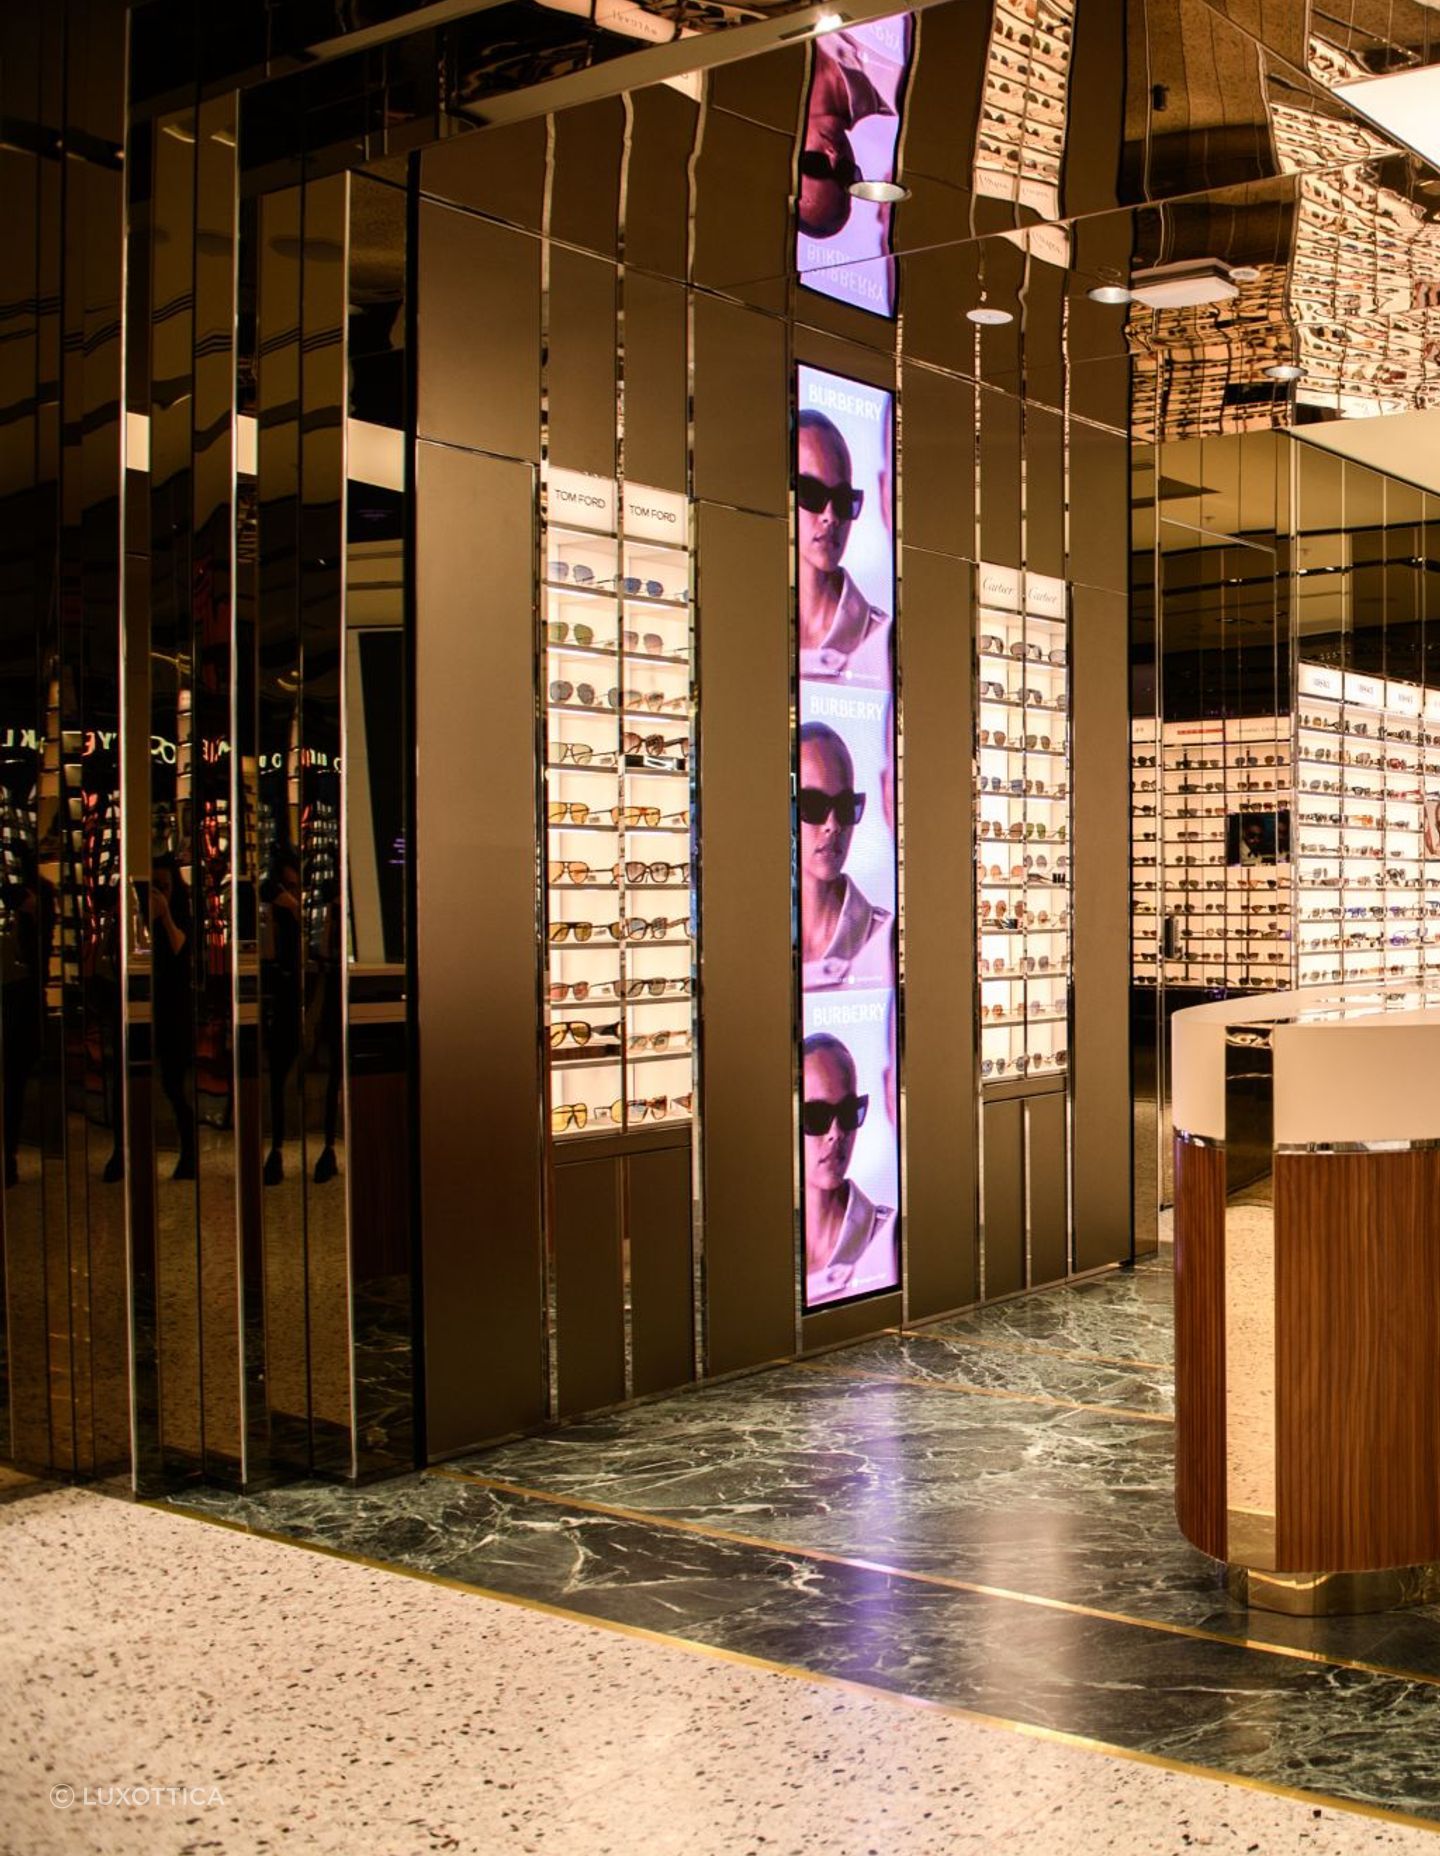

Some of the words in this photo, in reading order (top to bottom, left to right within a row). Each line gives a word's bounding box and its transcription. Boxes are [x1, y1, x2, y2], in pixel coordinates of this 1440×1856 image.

[808, 383, 881, 419] BURBERRY
[555, 489, 577, 503] TOM
[578, 496, 606, 509] FORD
[629, 504, 650, 517] TOM
[651, 510, 677, 523] FORD
[809, 695, 884, 721] BURBERRY
[813, 1002, 887, 1027] BURBERRY
